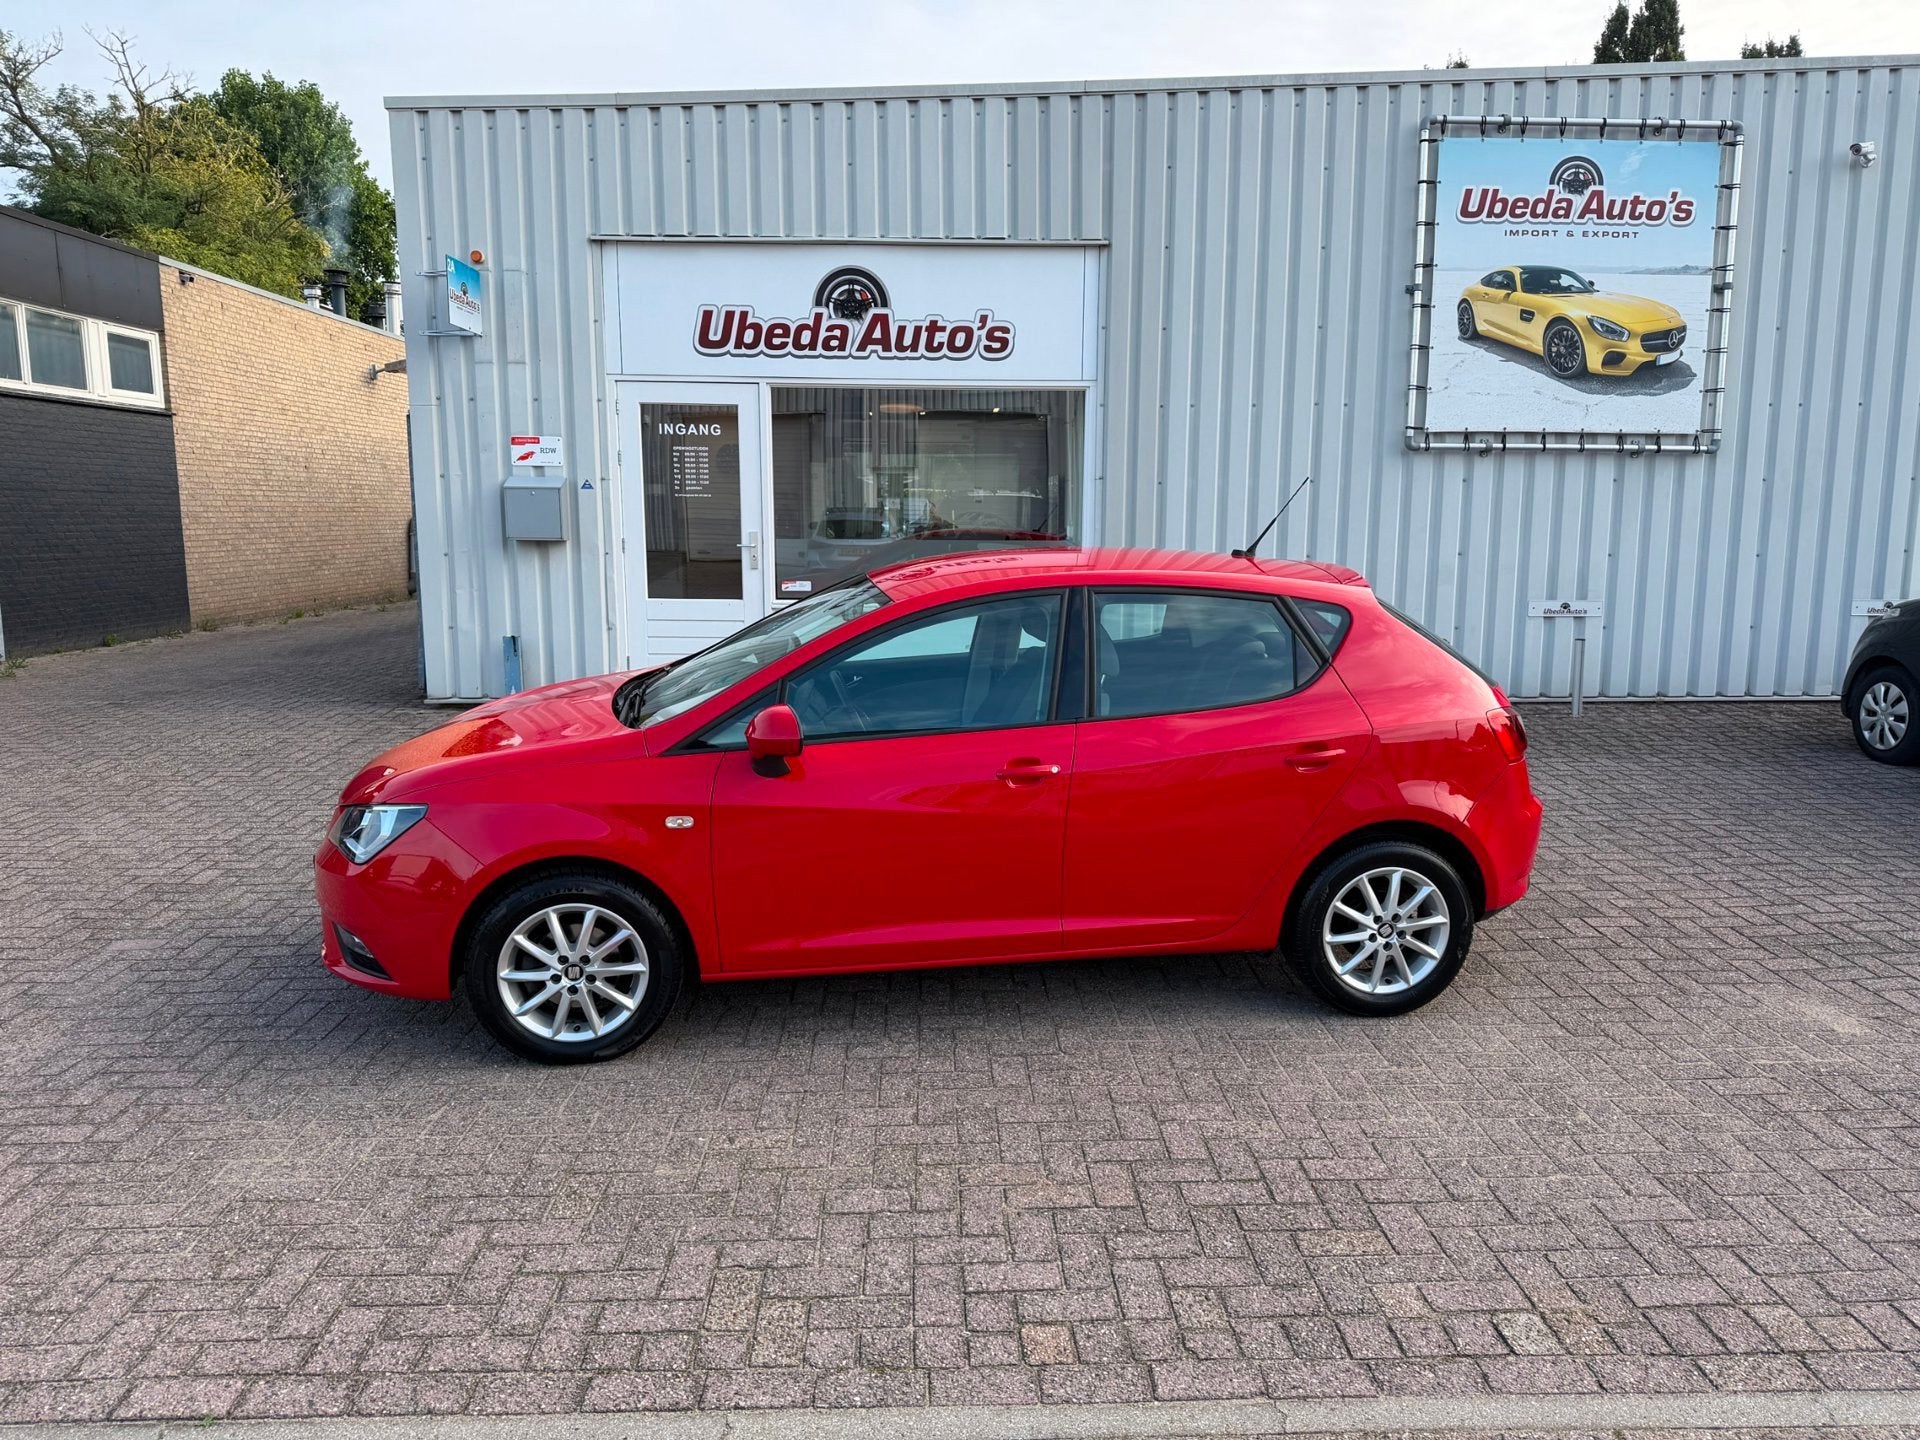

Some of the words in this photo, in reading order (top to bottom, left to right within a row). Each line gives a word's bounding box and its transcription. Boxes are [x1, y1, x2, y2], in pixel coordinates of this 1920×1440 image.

[1459, 188, 1574, 220] Ubeda
[1577, 189, 1694, 222] Auto's
[1504, 229, 1558, 238] IMPORT
[1566, 230, 1575, 238] &
[1582, 230, 1640, 239] EXPORT
[698, 309, 850, 352] Ubeda
[855, 312, 1011, 354] Auto's
[658, 423, 721, 436] INGANG
[1543, 607, 1564, 615] Ubeda
